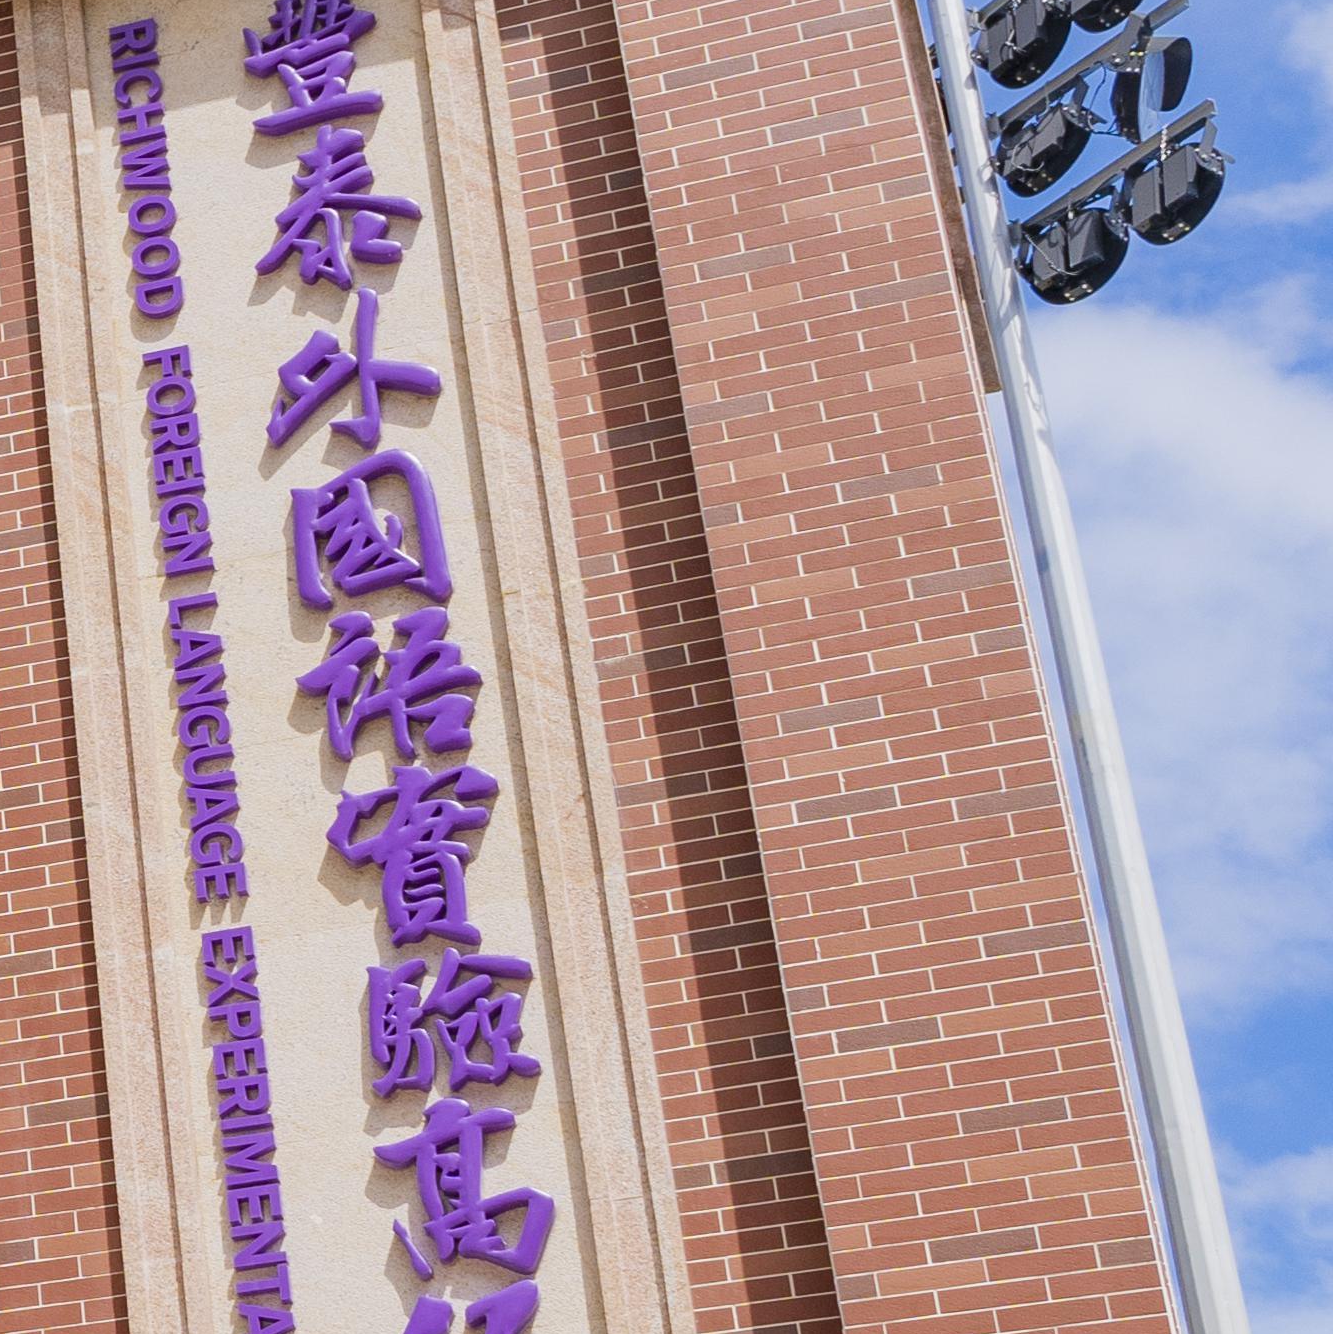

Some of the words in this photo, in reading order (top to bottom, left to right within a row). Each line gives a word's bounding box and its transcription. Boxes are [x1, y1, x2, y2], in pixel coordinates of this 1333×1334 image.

[108, 17, 183, 320] RICHWOOD
[142, 344, 215, 578] FOREIGN
[168, 591, 248, 904] LANGUAGE
